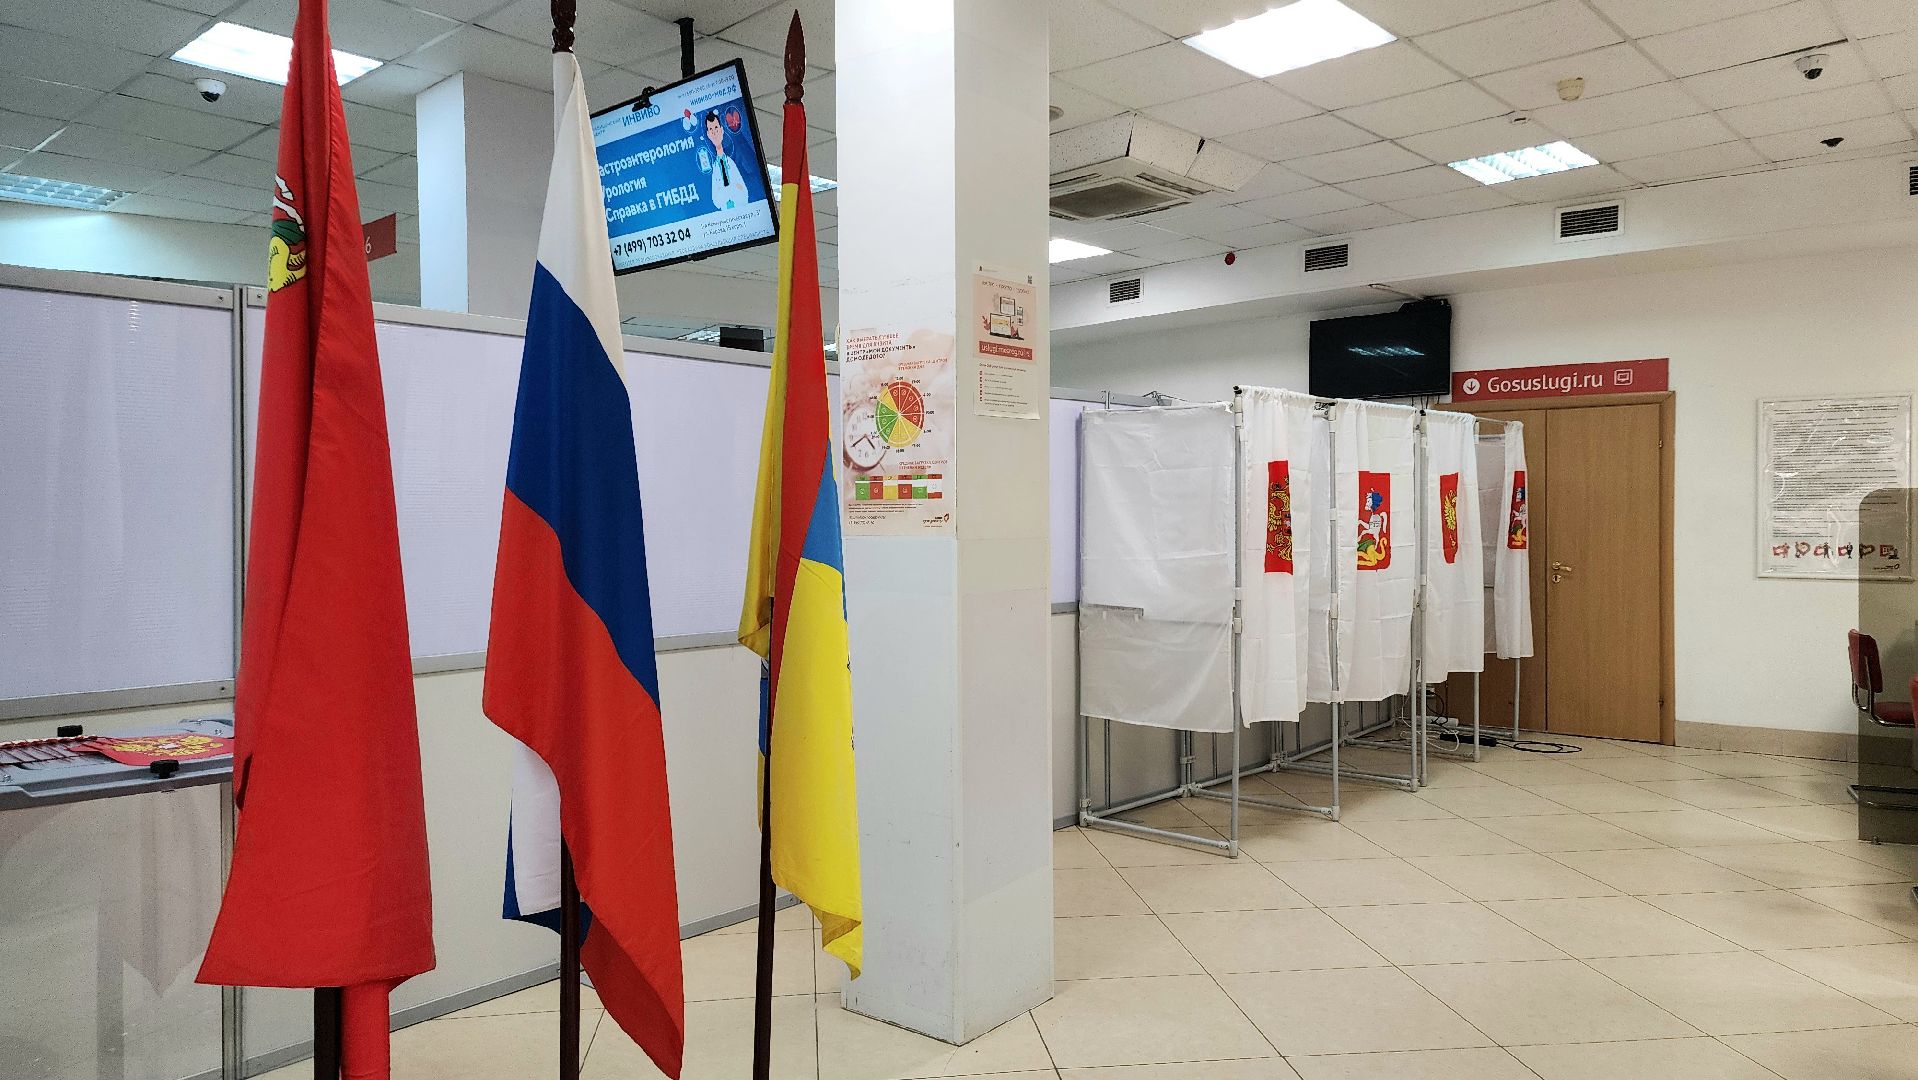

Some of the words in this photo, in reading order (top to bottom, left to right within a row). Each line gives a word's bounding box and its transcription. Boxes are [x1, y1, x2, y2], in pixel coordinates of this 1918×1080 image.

[621, 104, 661, 127] ИНВИВО
[598, 136, 695, 177] астроэнтерология
[602, 176, 647, 202] рология
[606, 201, 649, 223] Справка
[649, 198, 656, 211] в
[655, 183, 700, 208] ГИБДД
[613, 244, 622, 256] +7
[624, 238, 647, 258] (499)
[646, 233, 665, 248] 703
[664, 230, 677, 245] 32
[677, 228, 691, 242] 04
[1487, 371, 1603, 393] Gosuslugi.ru
